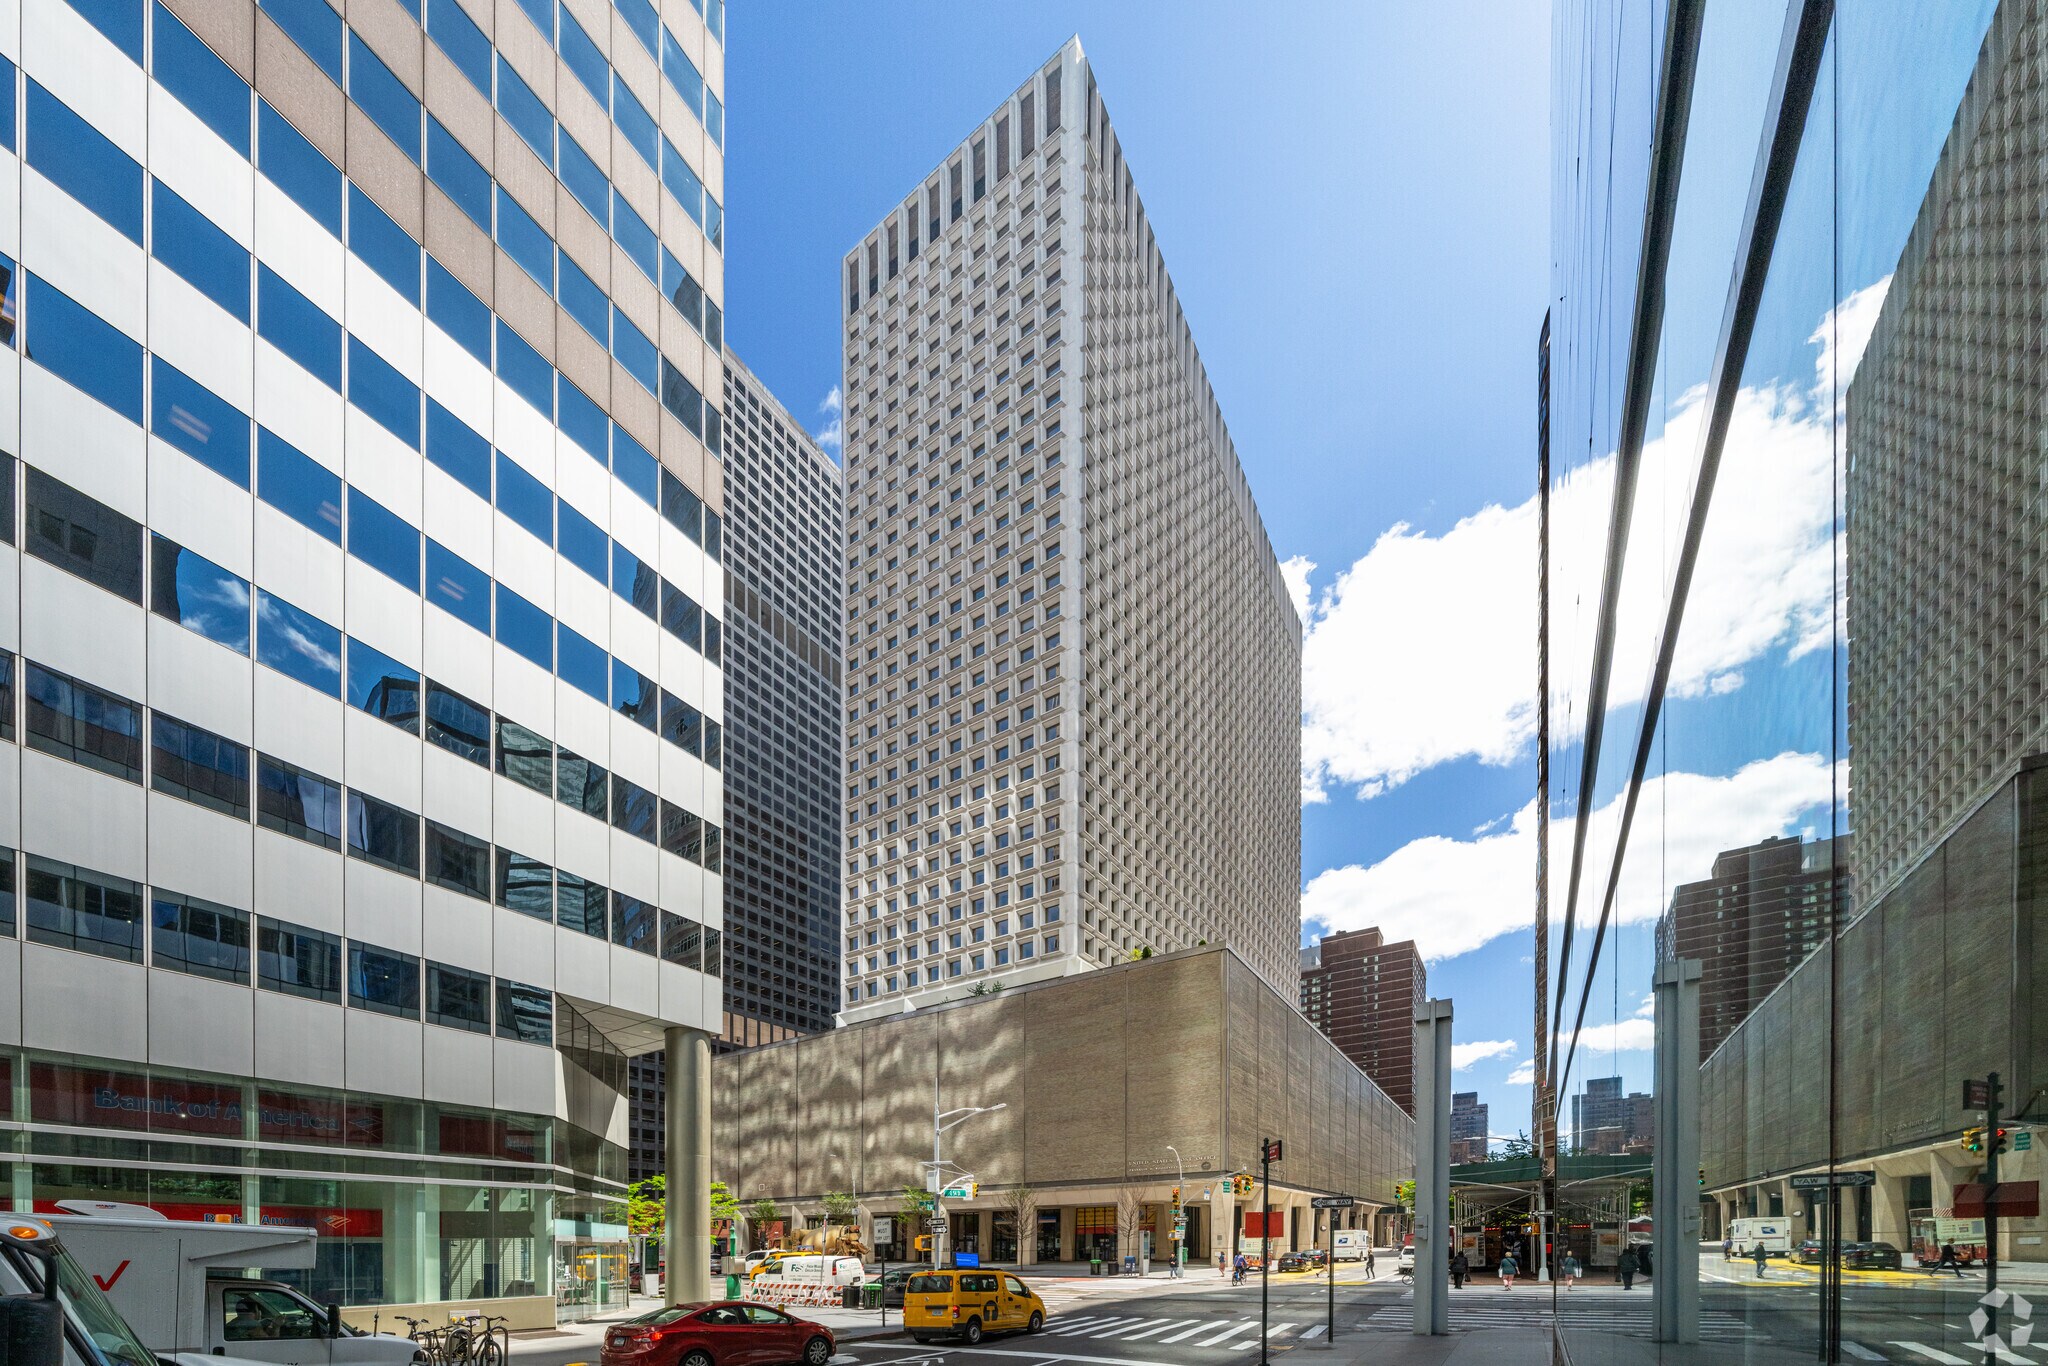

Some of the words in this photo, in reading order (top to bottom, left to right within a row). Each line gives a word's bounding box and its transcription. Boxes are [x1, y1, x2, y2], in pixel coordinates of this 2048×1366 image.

[94, 1086, 184, 1117] Bank
[187, 1099, 220, 1119] of
[204, 1213, 242, 1224] Bk
